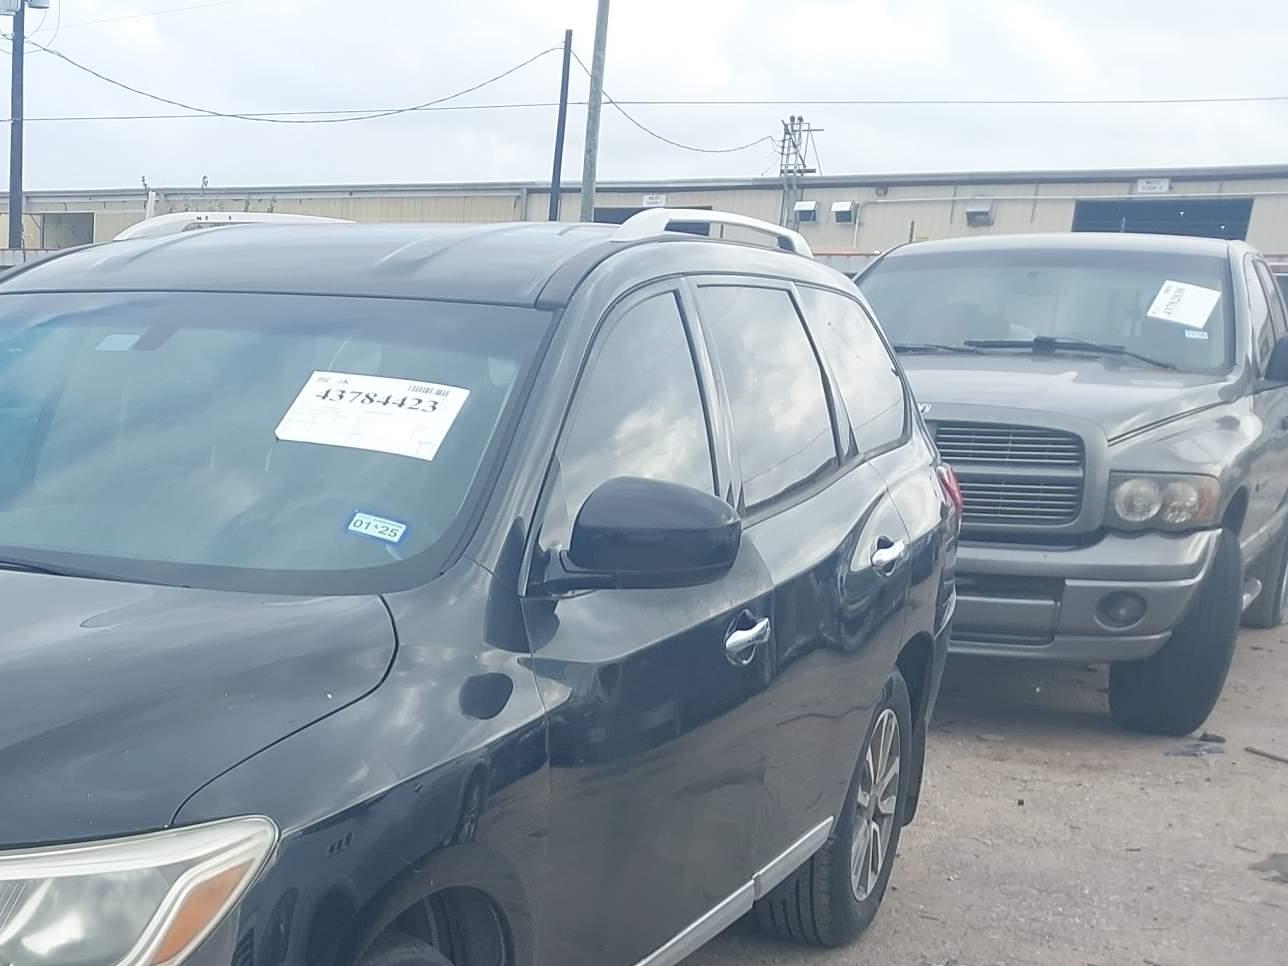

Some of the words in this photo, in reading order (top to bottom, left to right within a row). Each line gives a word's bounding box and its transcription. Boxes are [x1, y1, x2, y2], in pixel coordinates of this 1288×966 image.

[315, 387, 439, 413] 43784423
[353, 518, 371, 531] 01
[378, 525, 400, 538] 25
